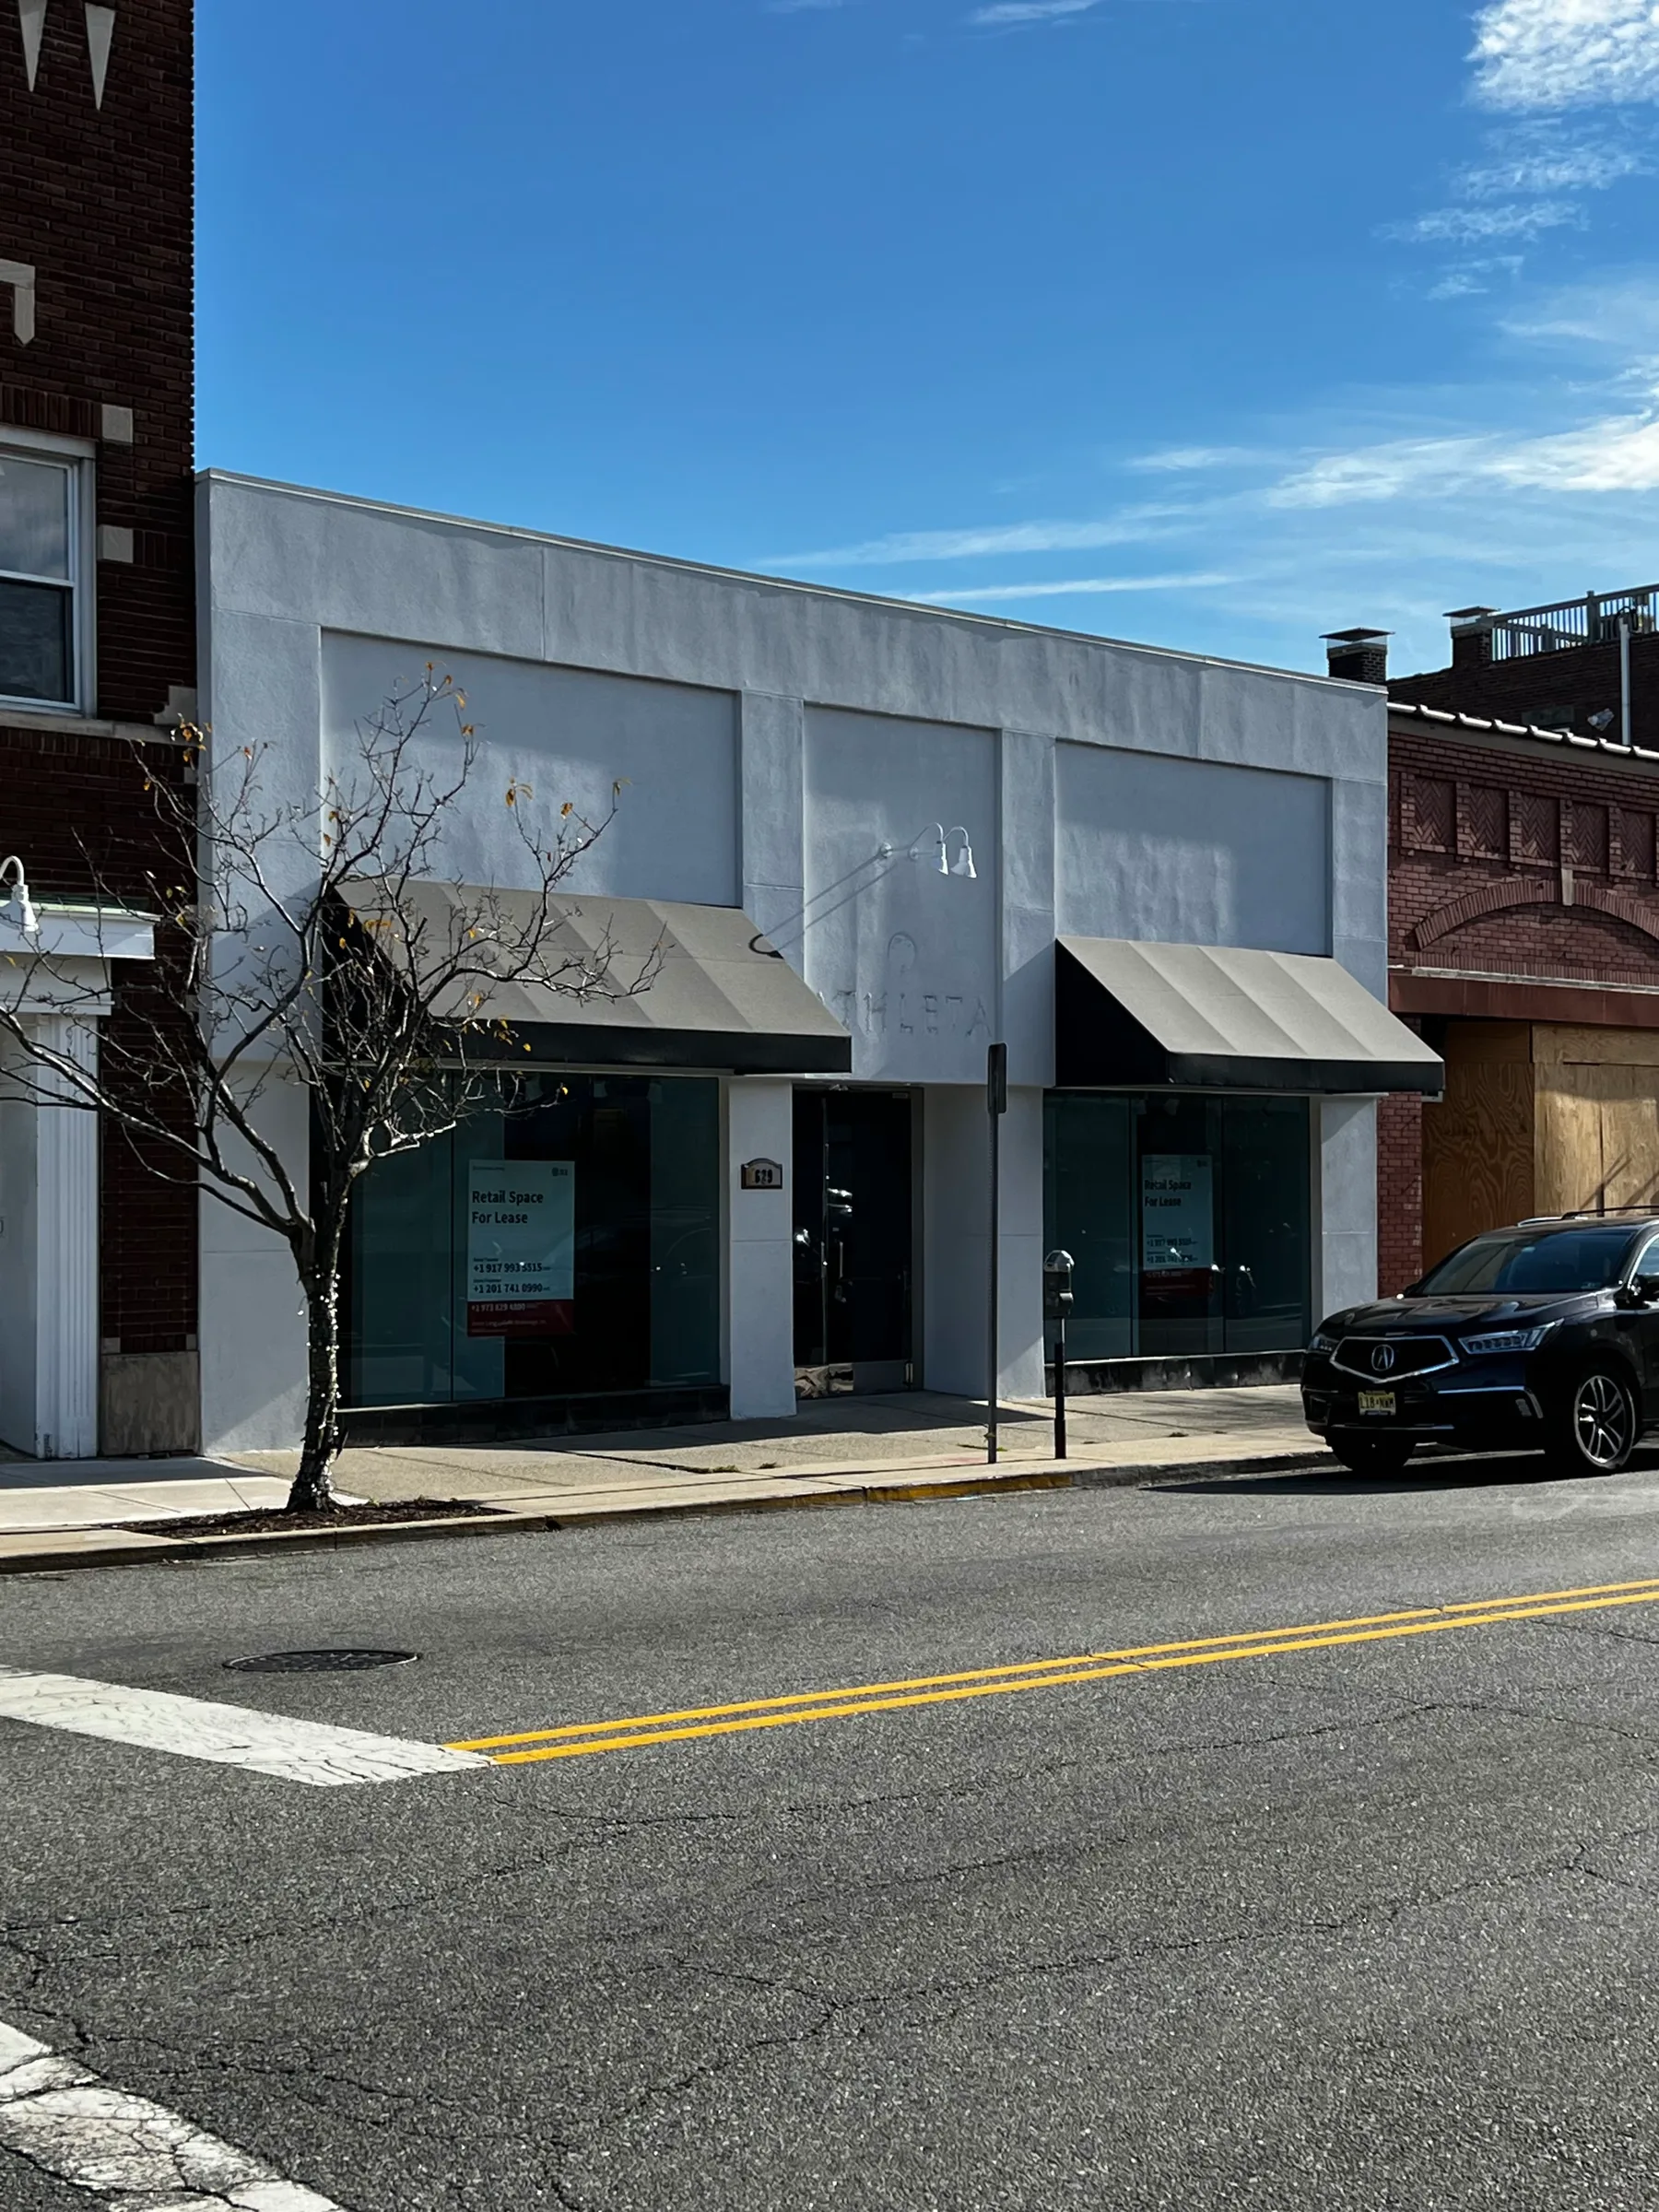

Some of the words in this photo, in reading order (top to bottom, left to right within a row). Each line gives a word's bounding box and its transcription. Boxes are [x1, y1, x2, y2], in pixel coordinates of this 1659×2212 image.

[818, 991, 992, 1037] THLETA
[472, 1190, 506, 1204] Retail
[509, 1191, 544, 1206] Space
[472, 1211, 492, 1224] For
[495, 1211, 528, 1224] Lease
[474, 1264, 484, 1273] +1
[486, 1263, 502, 1273] 917
[504, 1263, 521, 1273] 993
[474, 1285, 484, 1293] +1
[486, 1284, 501, 1293] 201
[504, 1283, 520, 1292] 741
